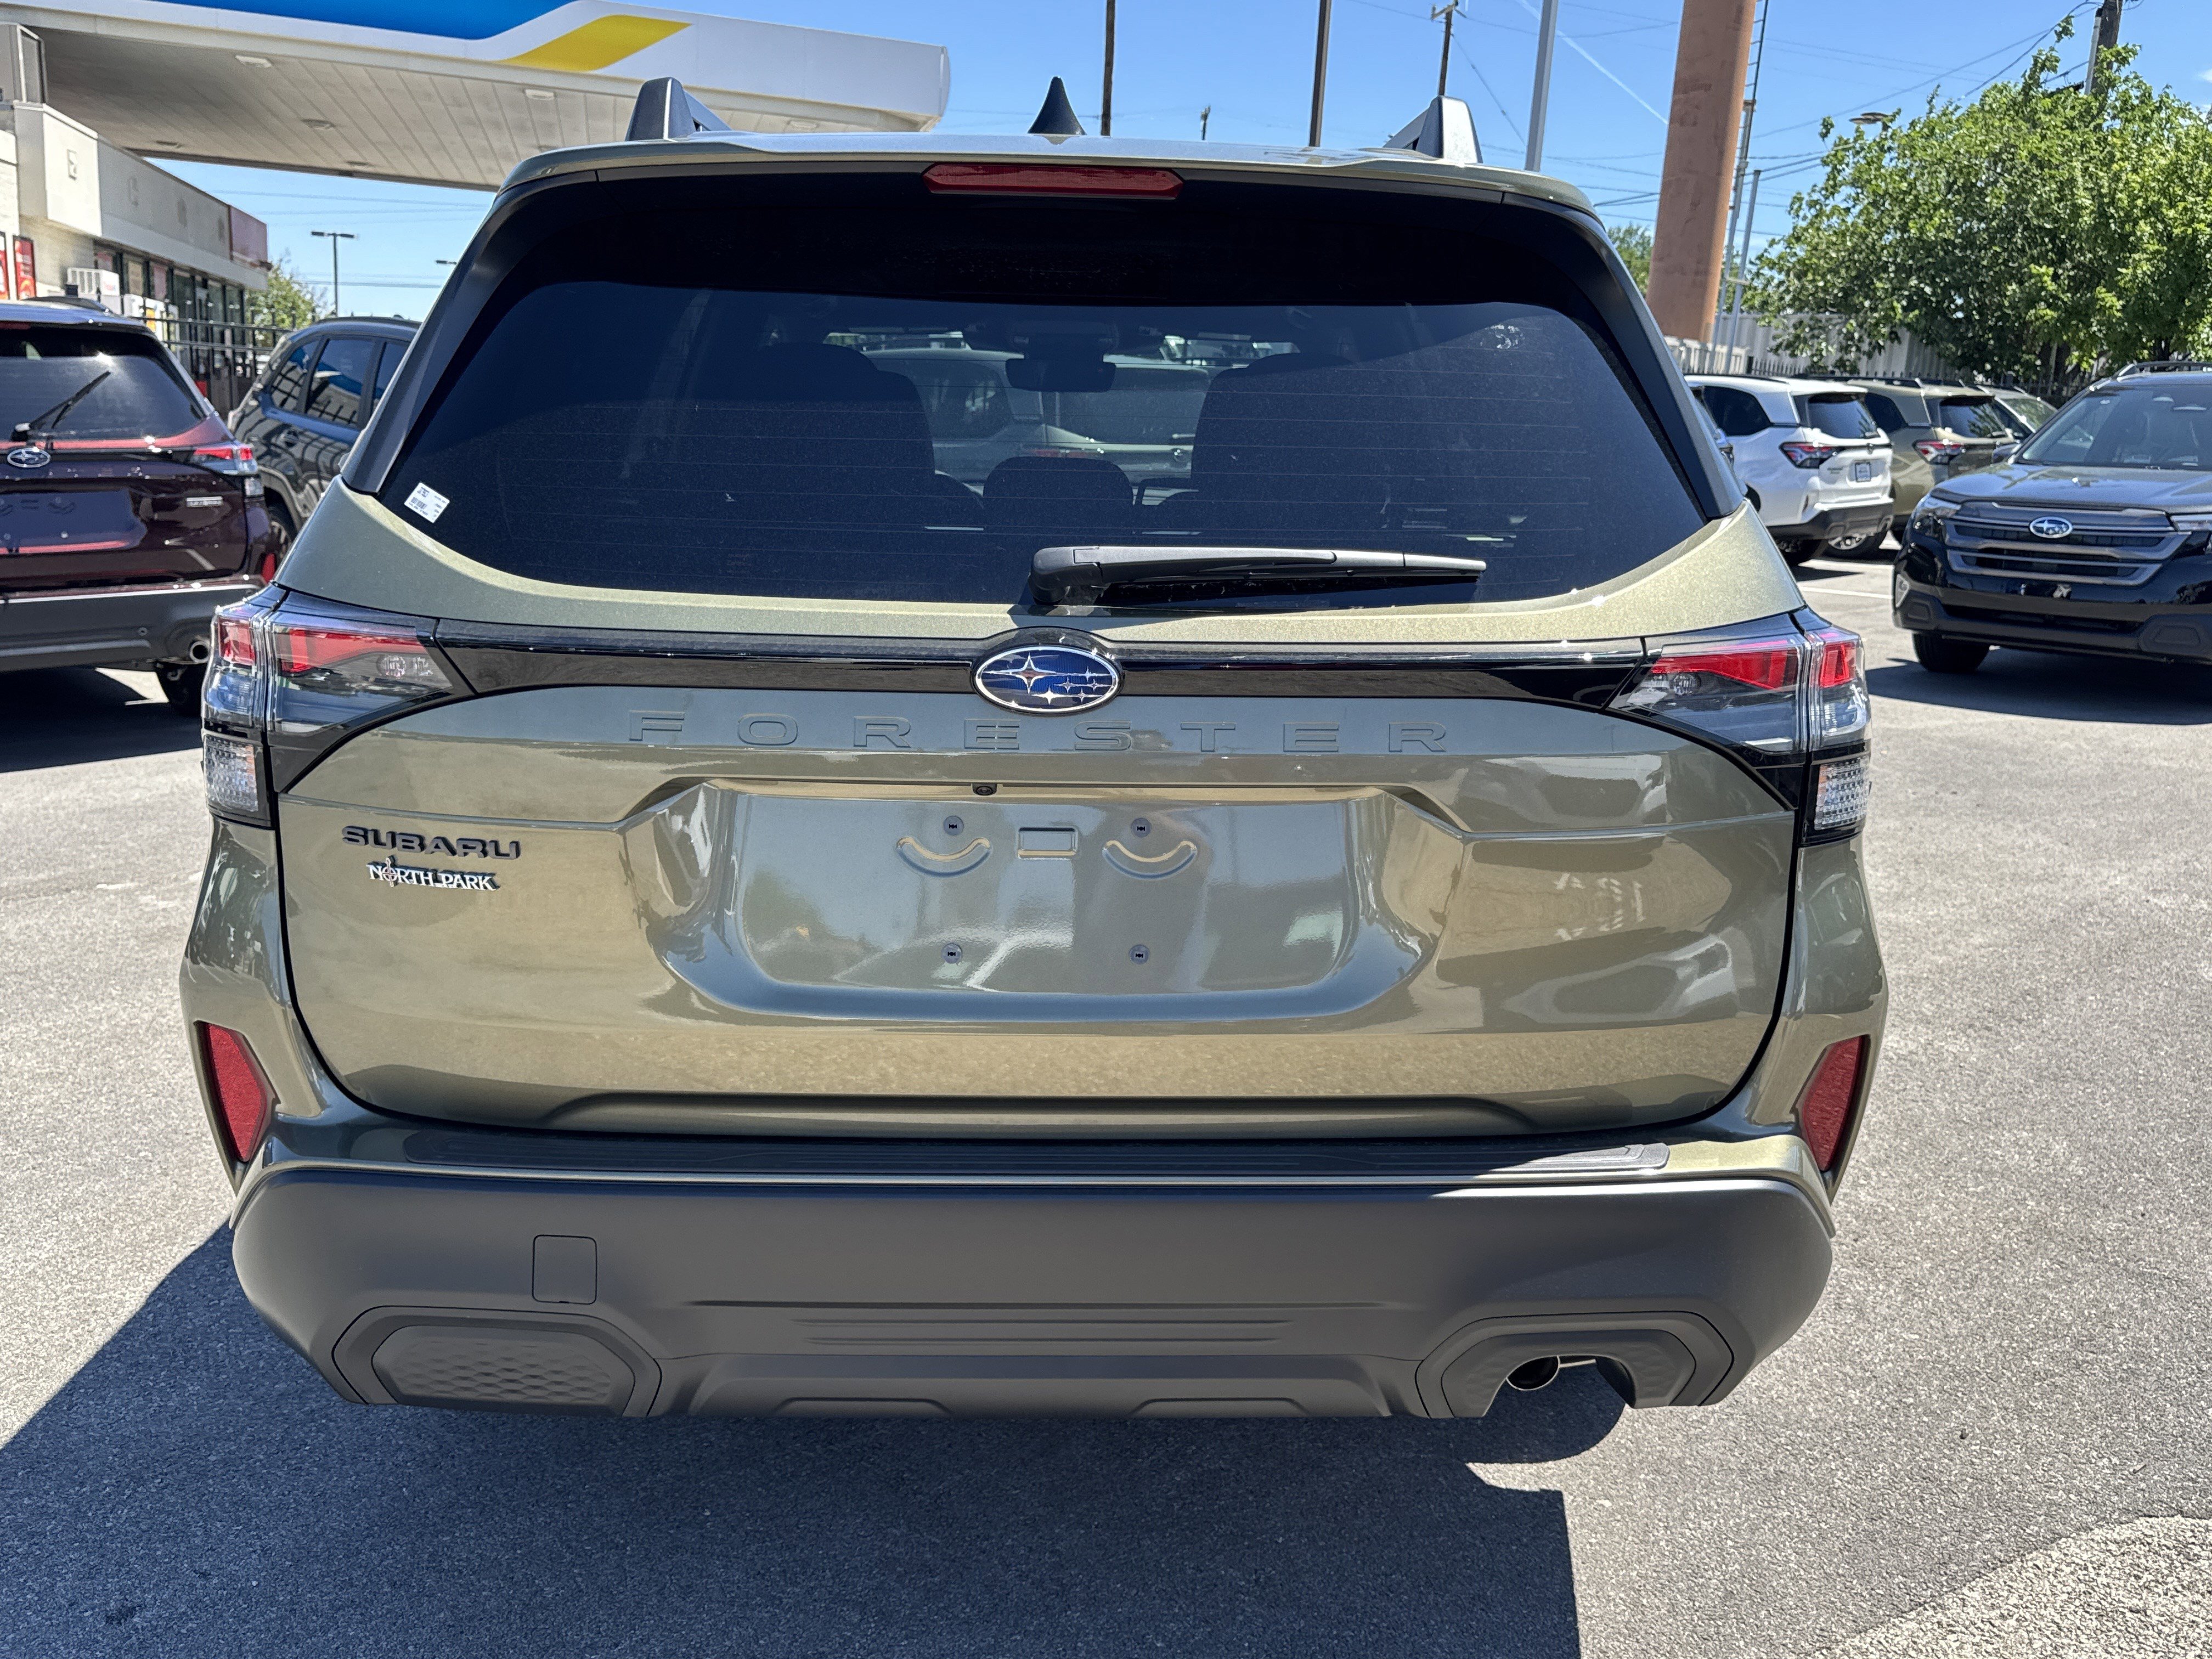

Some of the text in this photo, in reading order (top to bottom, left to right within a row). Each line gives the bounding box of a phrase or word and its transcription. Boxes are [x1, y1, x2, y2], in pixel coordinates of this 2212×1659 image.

[629, 710, 1447, 753] FORESTER
[342, 825, 522, 860] SUBARU
[366, 857, 498, 891] NORTH PARK
